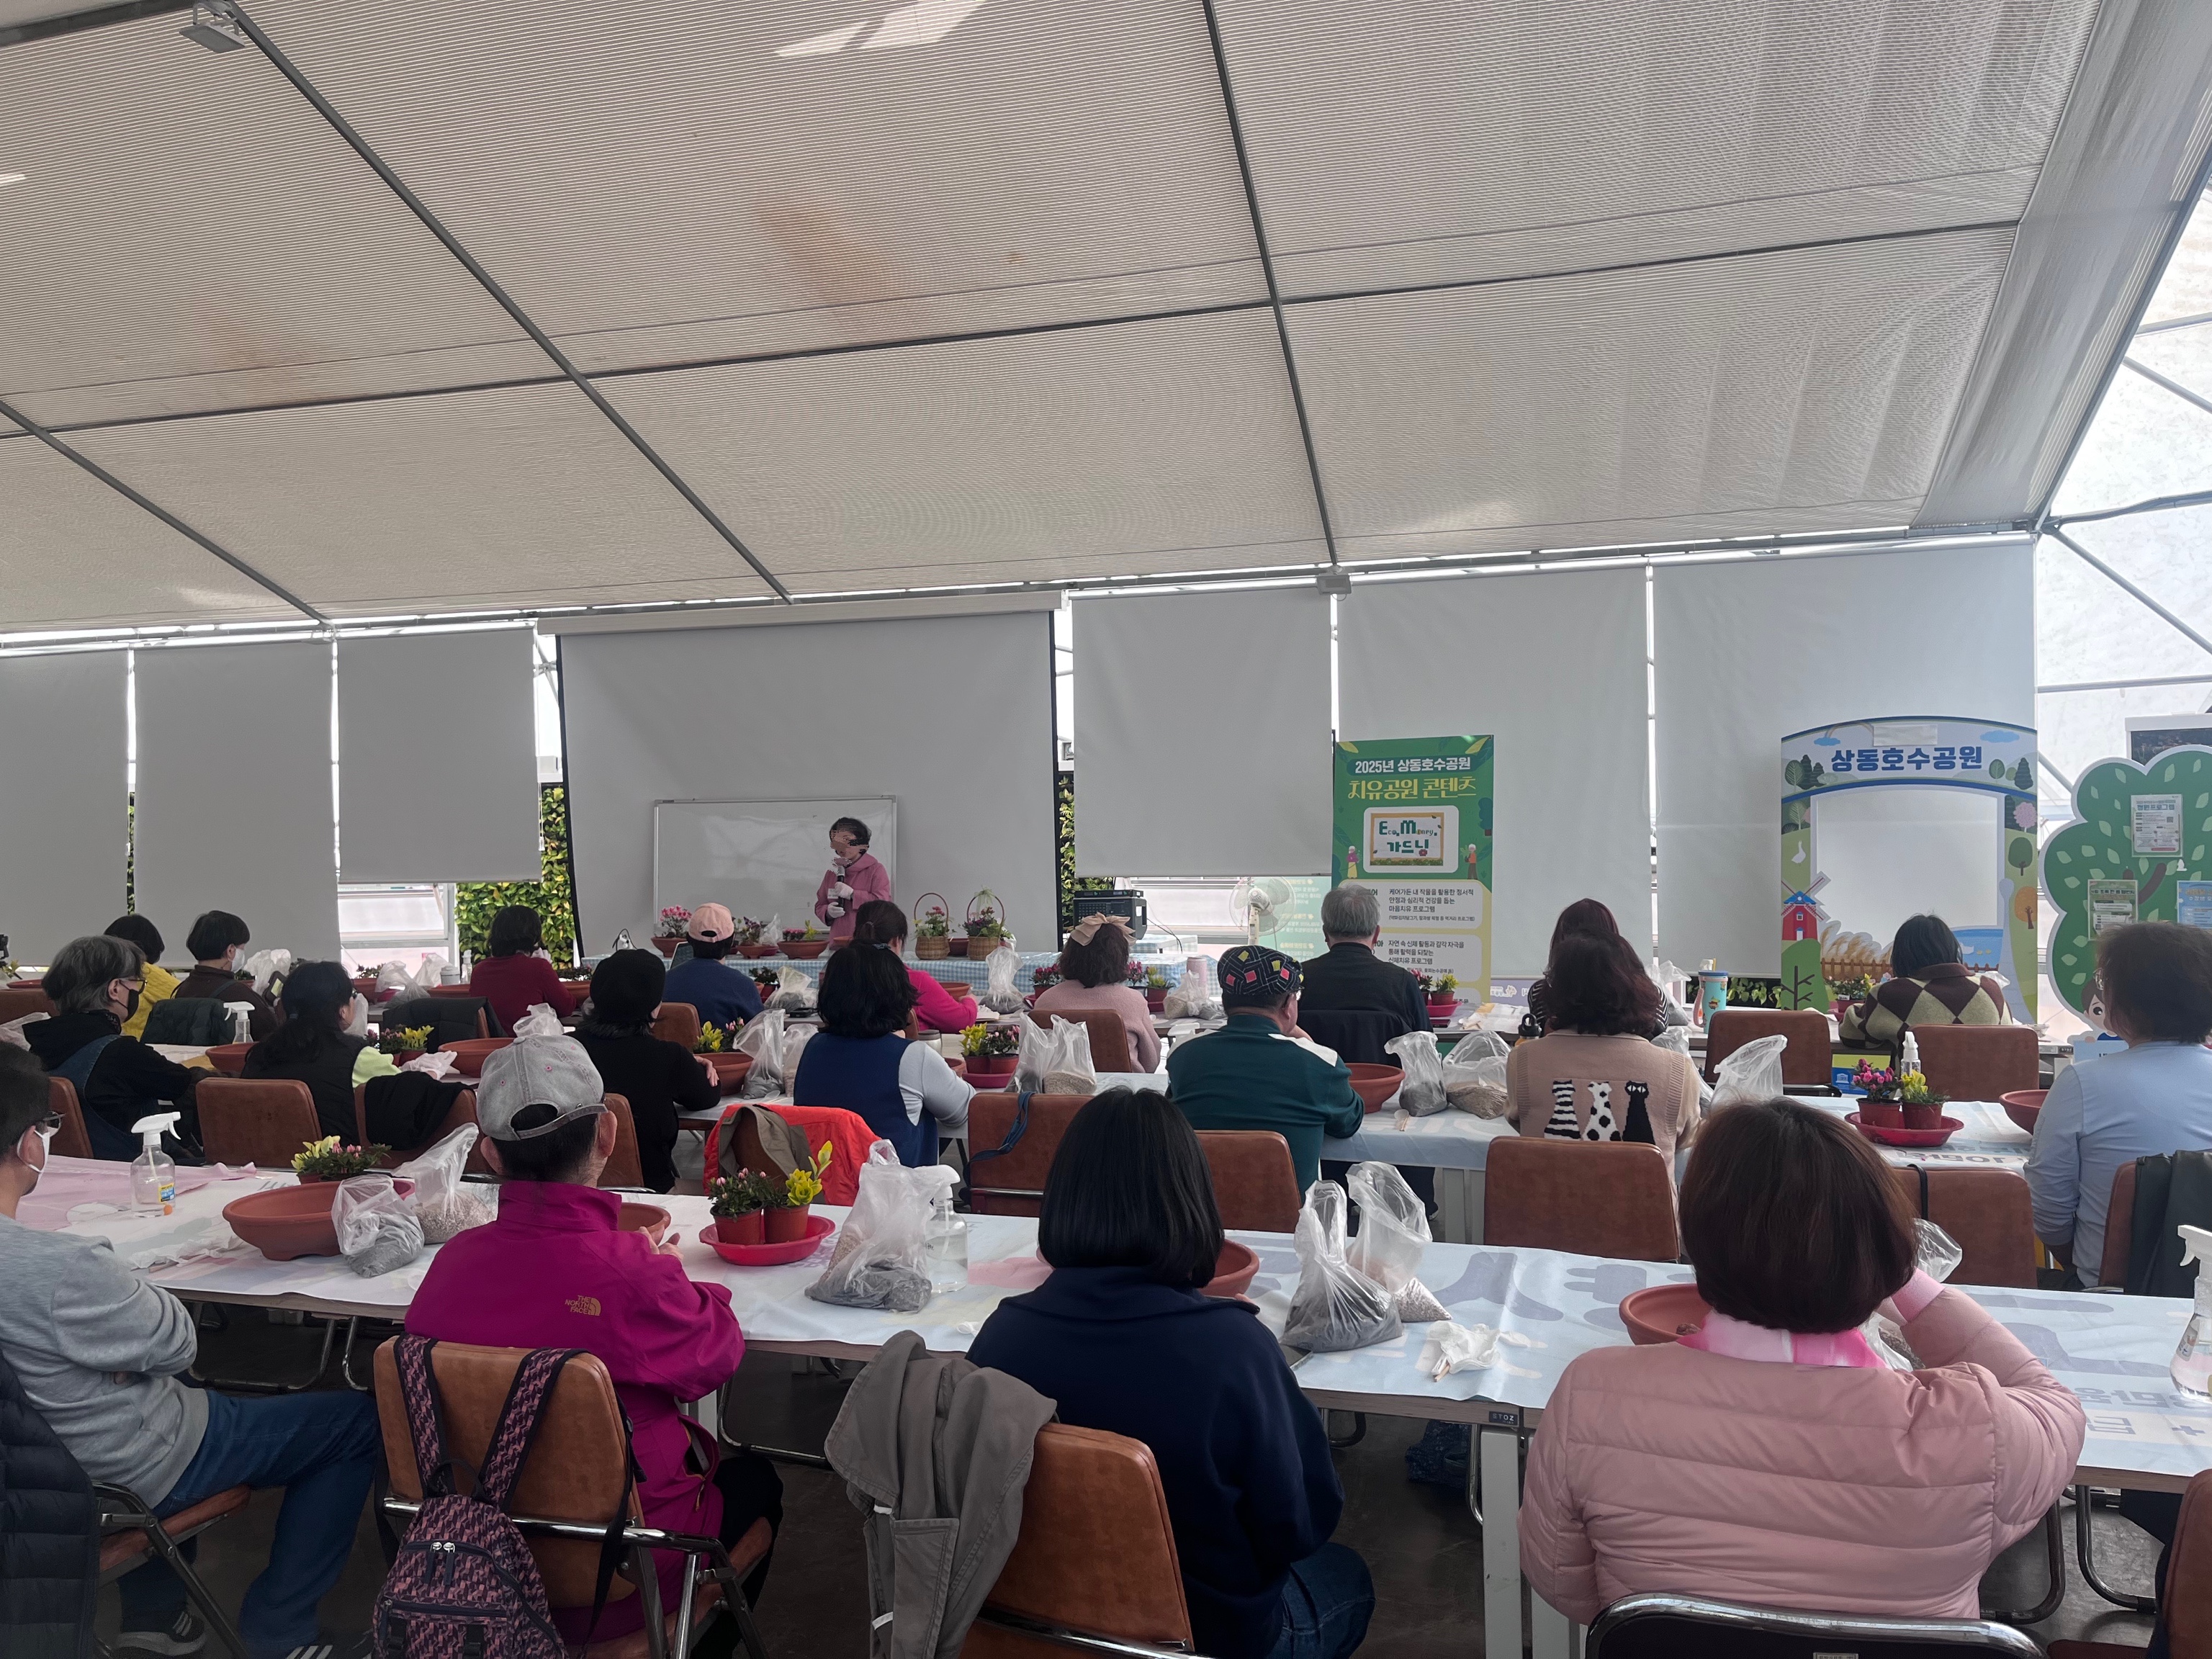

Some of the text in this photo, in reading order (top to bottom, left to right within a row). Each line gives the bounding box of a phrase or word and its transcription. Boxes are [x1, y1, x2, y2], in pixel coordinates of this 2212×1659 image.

[1355, 757, 1470, 773] 2025년 상동호수공원
[1831, 746, 1982, 771] 상동호수공원
[1348, 776, 1476, 800] 치유공원 콘텐츠
[565, 1299, 590, 1310] NORTH
[570, 1306, 588, 1315] FACE
[1492, 1413, 1514, 1421] STOZ
